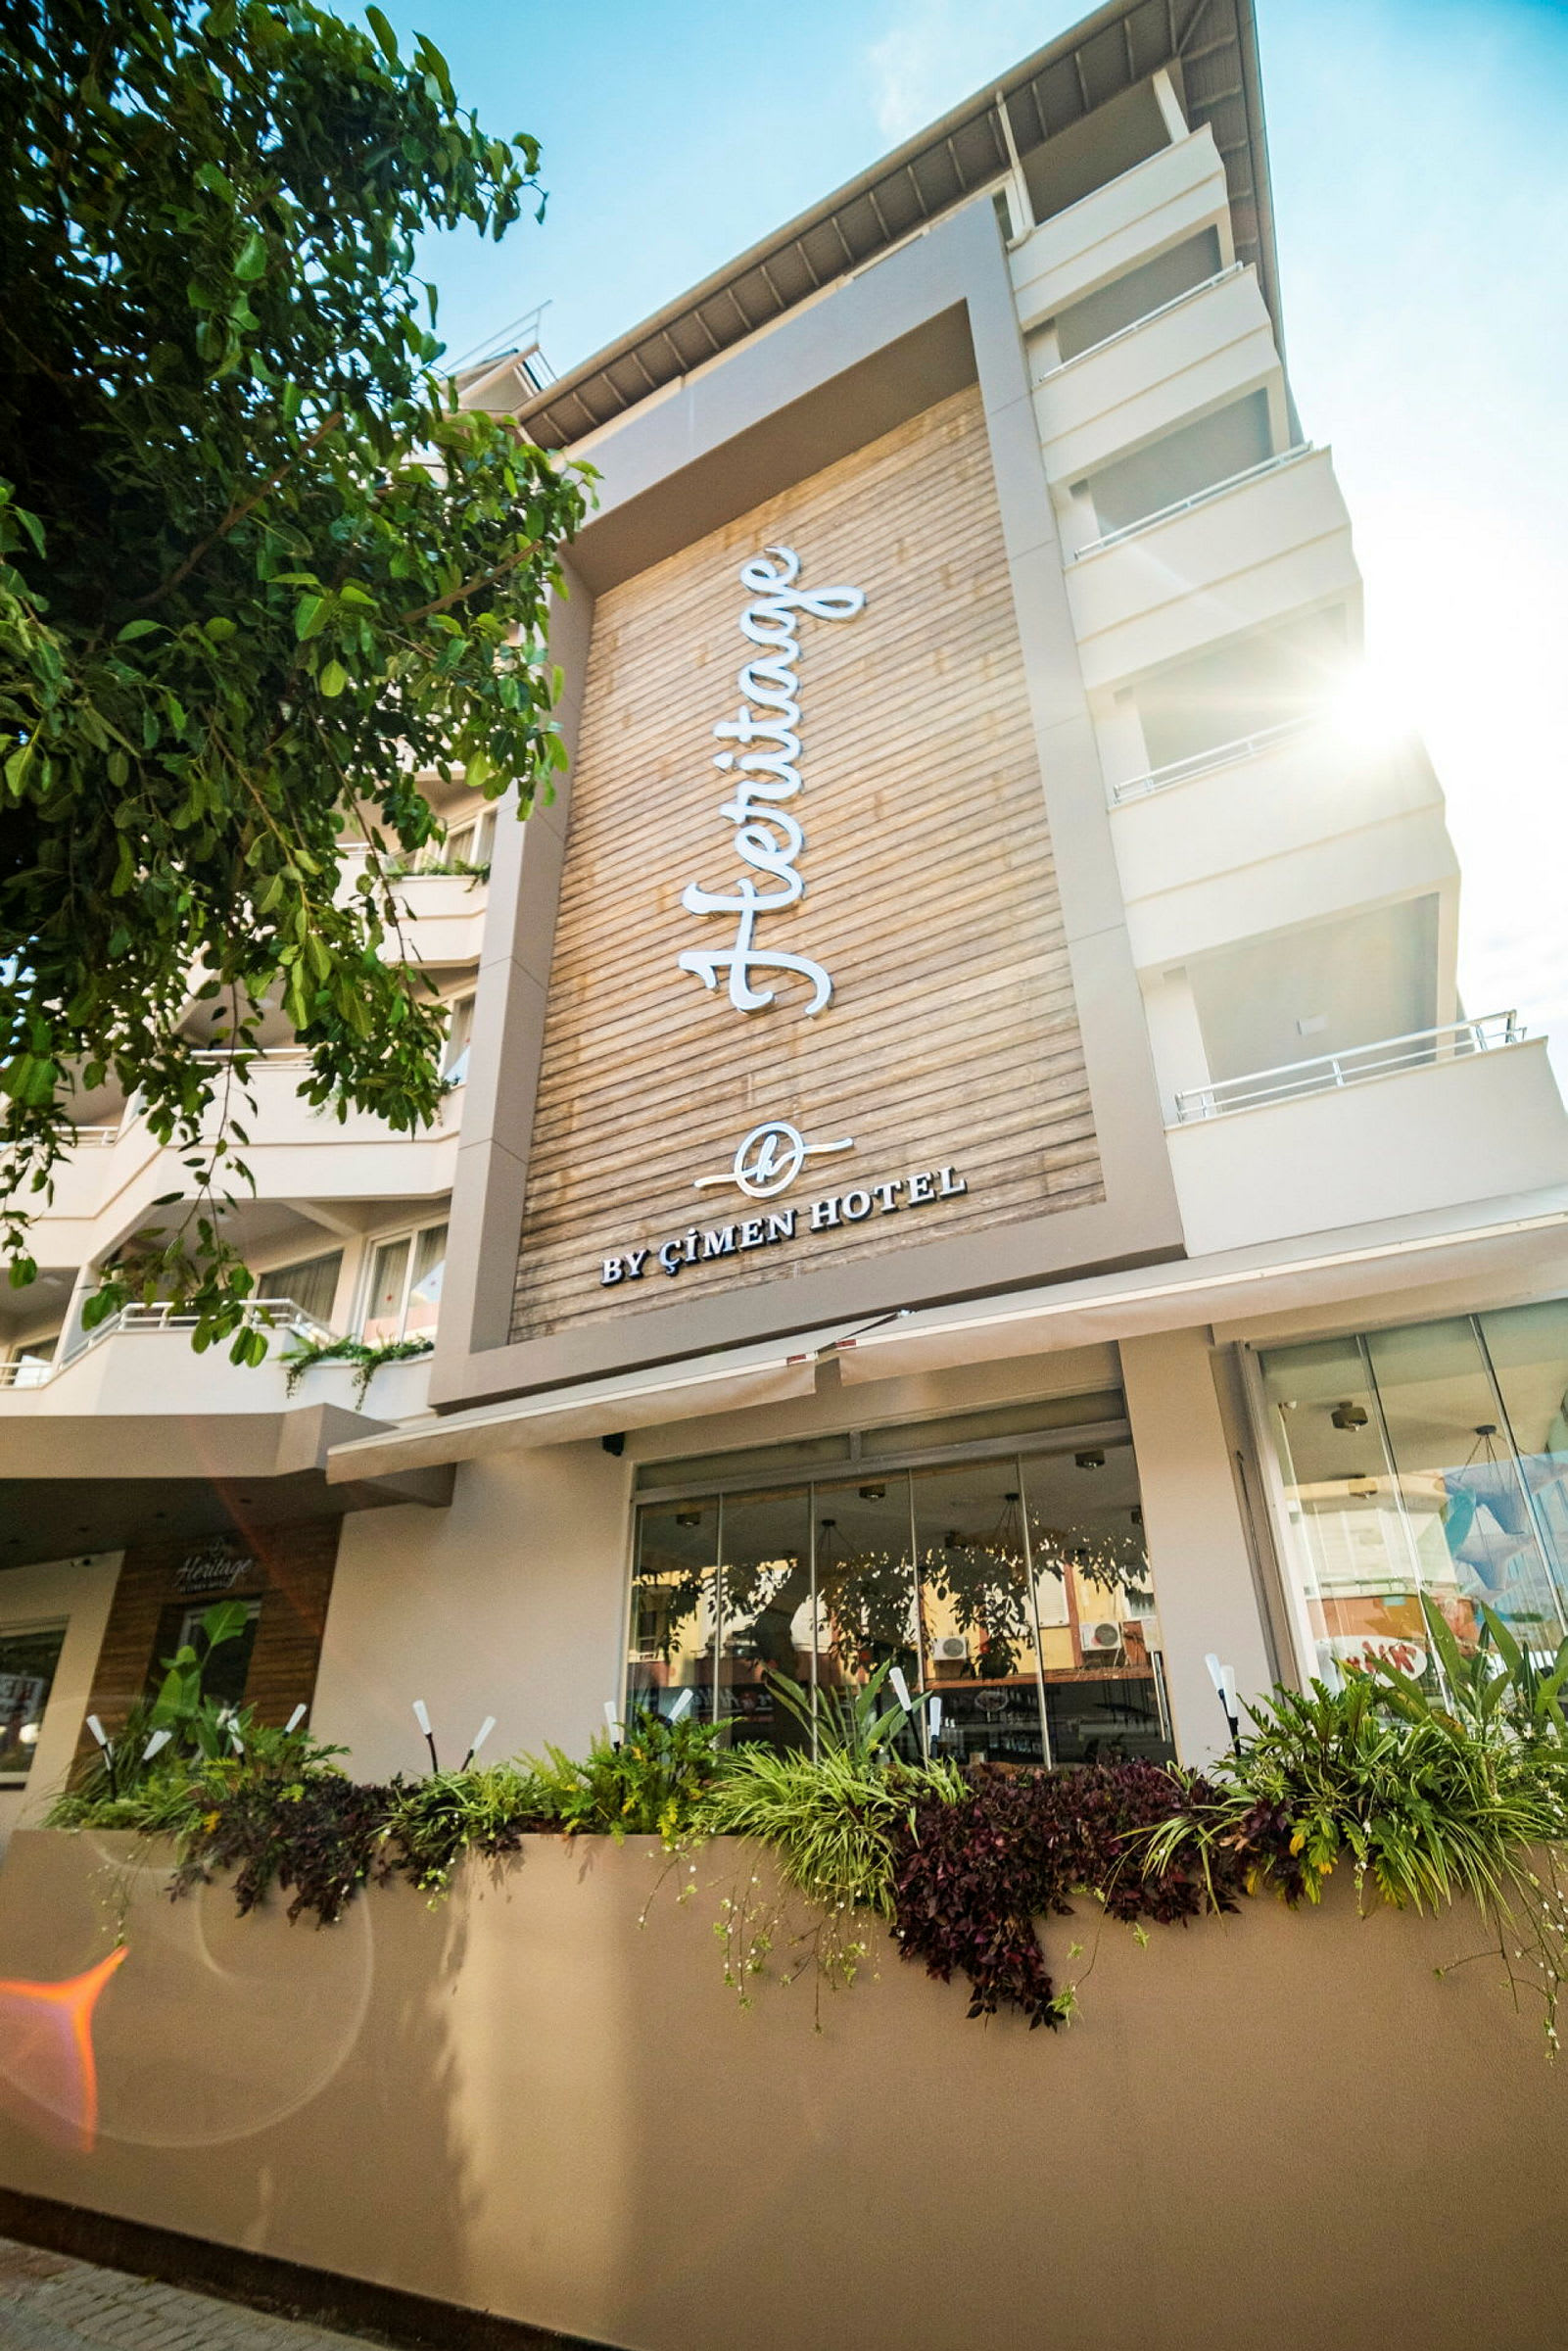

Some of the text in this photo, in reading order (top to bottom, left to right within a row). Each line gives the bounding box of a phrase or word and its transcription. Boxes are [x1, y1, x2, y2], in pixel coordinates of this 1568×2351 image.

[679, 546, 866, 1015] Heritage
[600, 1166, 968, 1285] BY ÇİMEN HOTEL
[173, 1556, 253, 1589] Heritage
